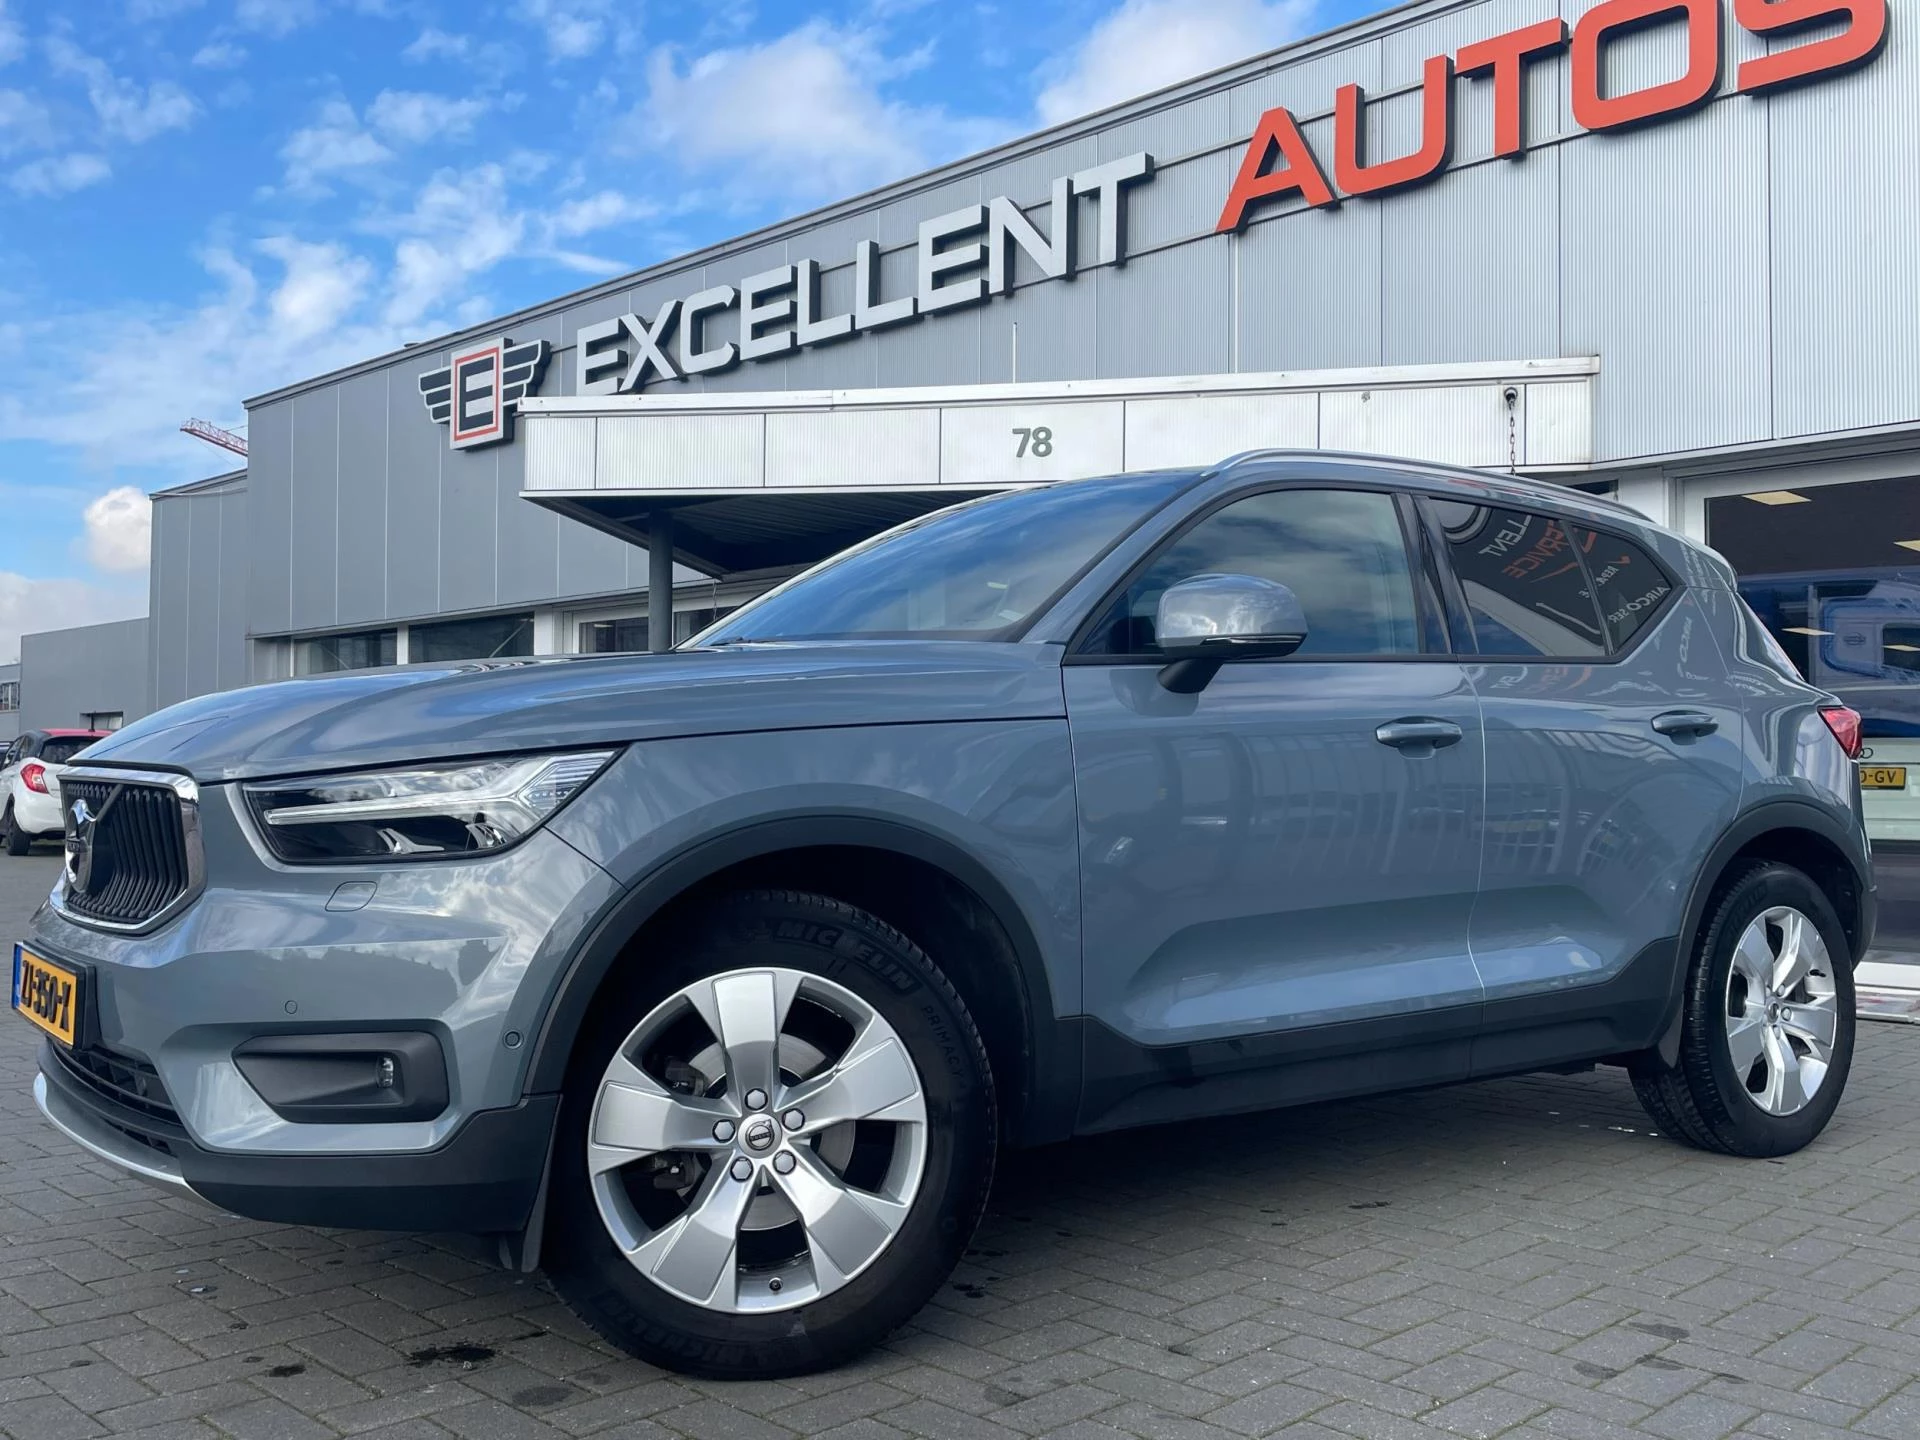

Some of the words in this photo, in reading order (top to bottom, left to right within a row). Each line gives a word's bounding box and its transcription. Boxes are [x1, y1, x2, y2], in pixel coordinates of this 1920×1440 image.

[576, 151, 1150, 396] EXCELLENT
[1216, 0, 1888, 234] AUTOS
[1012, 427, 1053, 458] 78
[921, 1005, 965, 1079] PRIMACY
